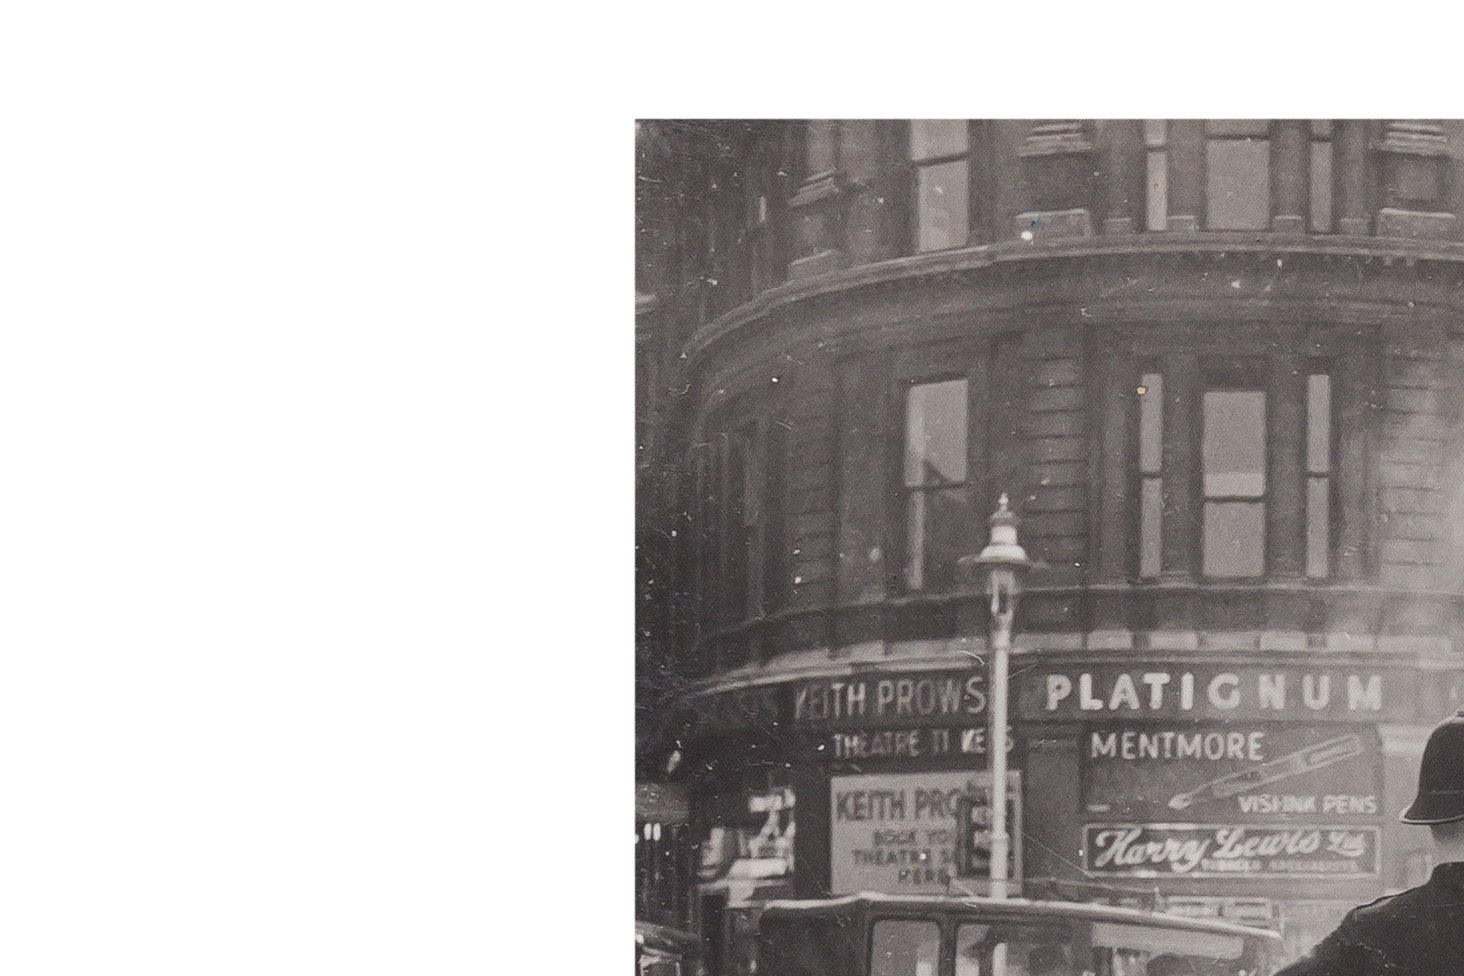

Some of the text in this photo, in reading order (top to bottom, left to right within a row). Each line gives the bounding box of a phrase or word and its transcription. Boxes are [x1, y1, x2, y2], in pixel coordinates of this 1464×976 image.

[794, 676, 987, 719] KEITH PROWS
[1046, 672, 1383, 711] PLATIGNUM
[1091, 731, 1265, 761] MENTMORE
[836, 787, 961, 821] KEITH PRO
[1323, 794, 1378, 814] PENS
[1094, 826, 1212, 873] Harry
[1211, 827, 1321, 859] Lewis
